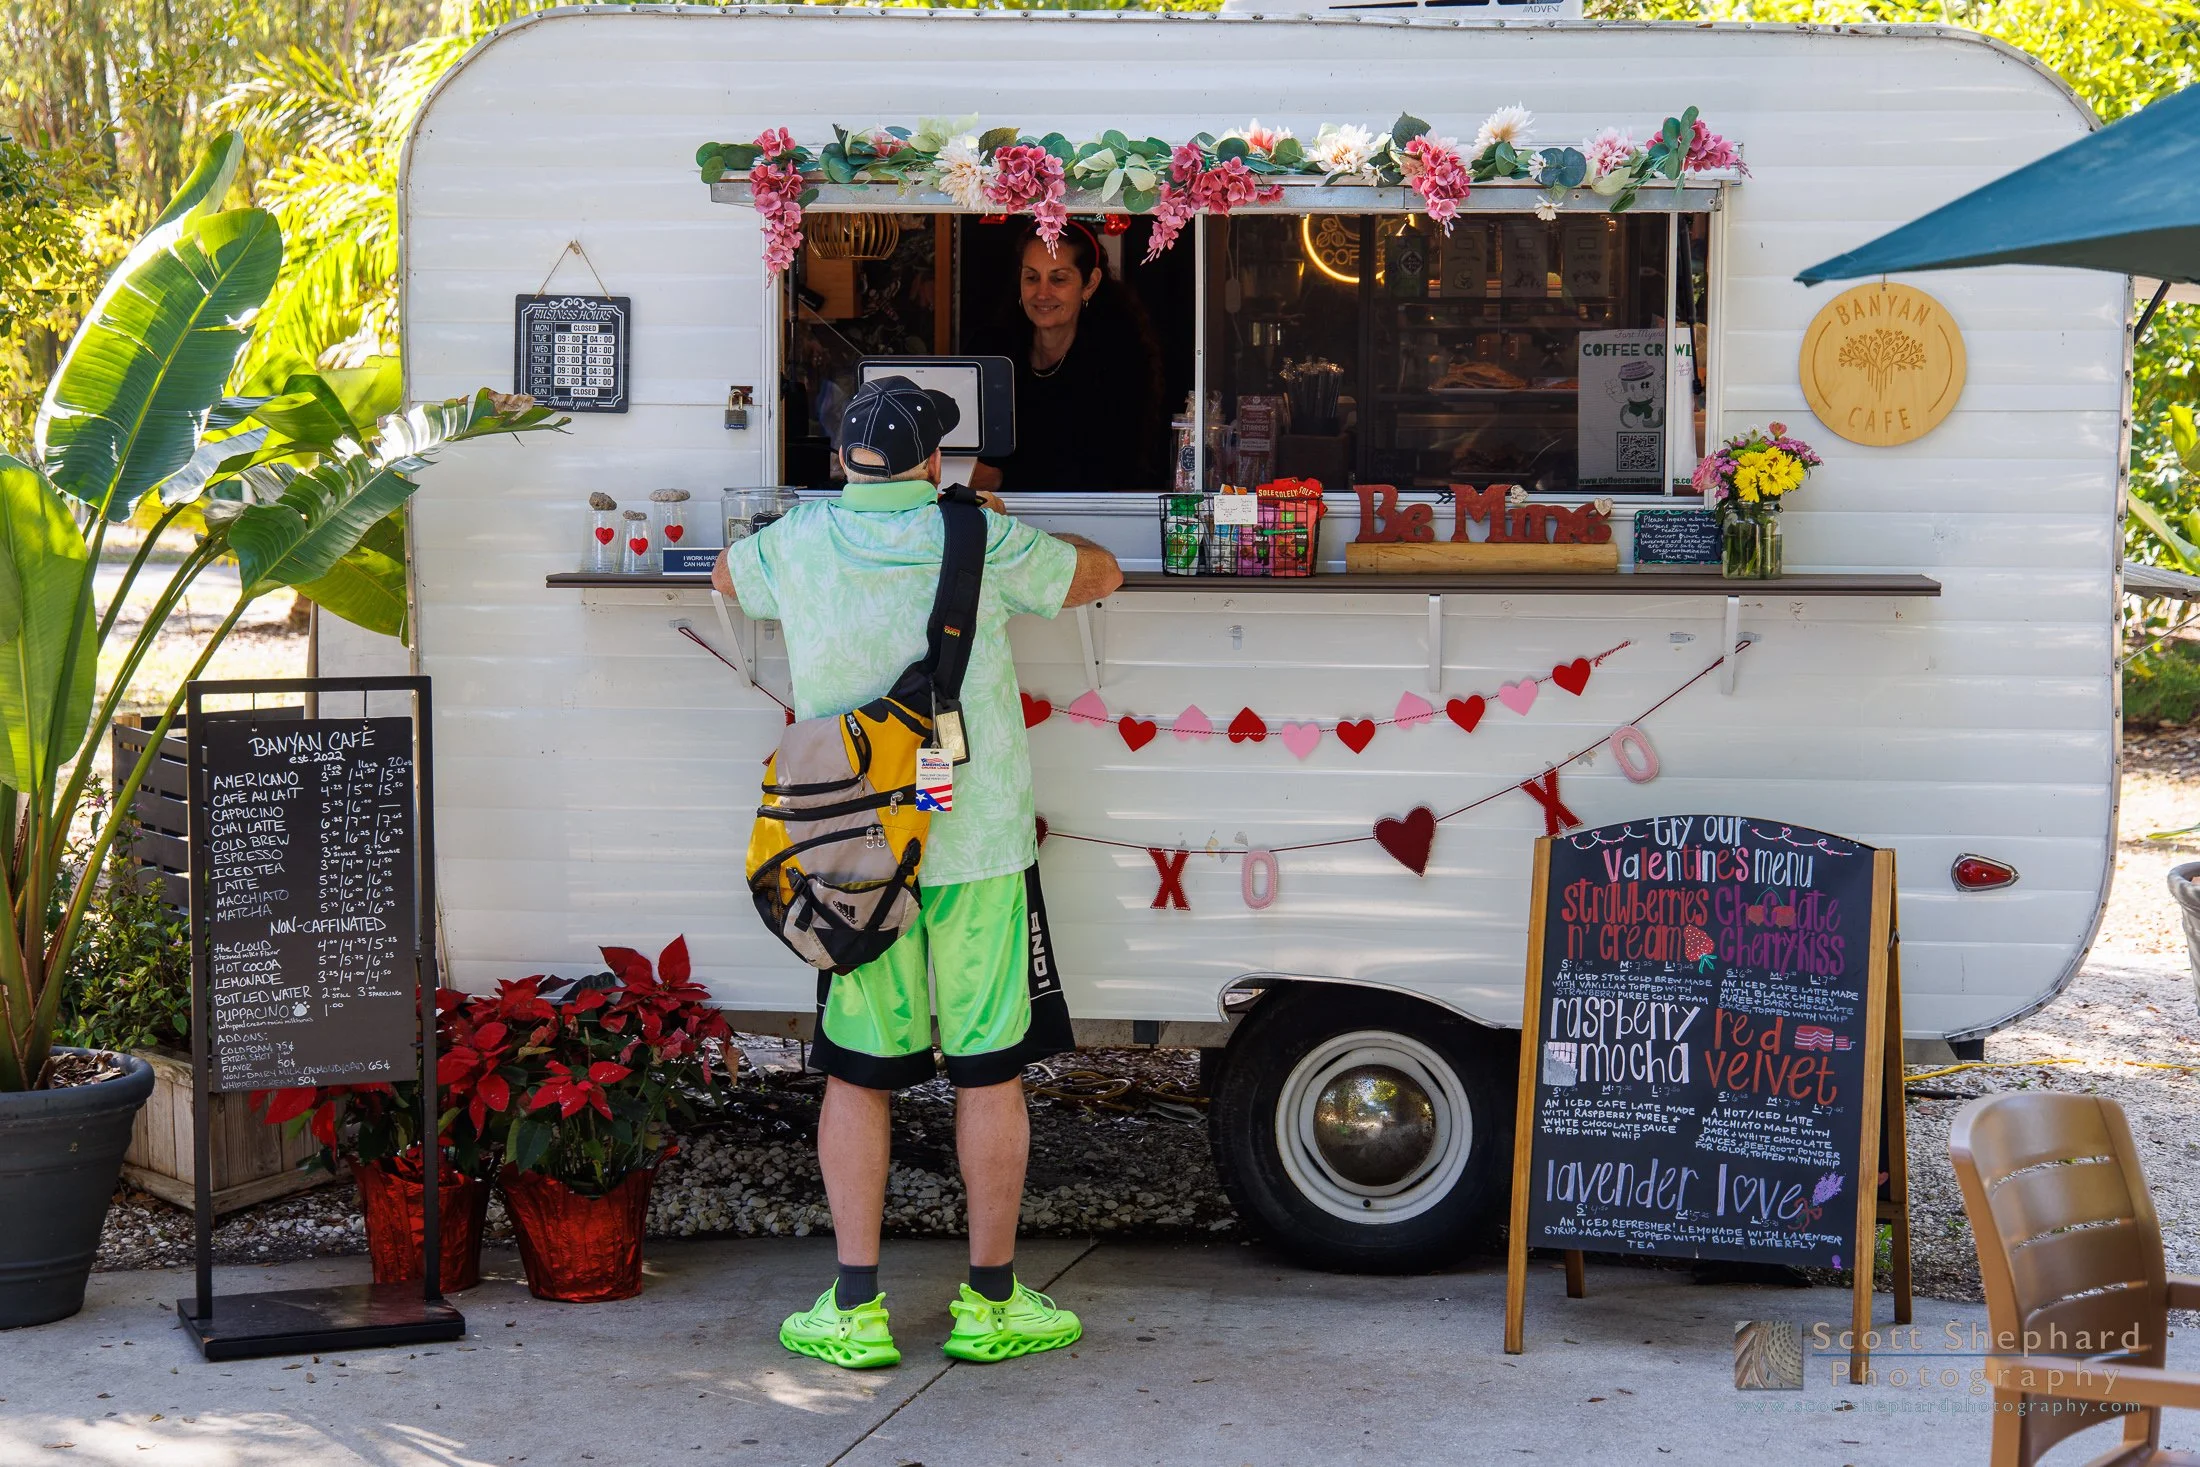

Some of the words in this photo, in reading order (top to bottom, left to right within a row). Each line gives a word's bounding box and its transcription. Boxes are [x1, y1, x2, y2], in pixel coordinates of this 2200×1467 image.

[534, 309, 578, 321] BUSINESS
[580, 310, 611, 321] HOURS
[1836, 295, 1931, 327] BANYAN
[1583, 344, 1640, 356] COFFEE
[1644, 344, 1693, 356] CRWL
[548, 397, 573, 406] Thank
[573, 400, 595, 410] you!
[1848, 407, 1911, 434] CAFE
[1353, 483, 1435, 544] Be
[248, 731, 322, 757] BANYAN
[213, 771, 298, 791] AMERICANO
[252, 791, 268, 802] AU
[271, 787, 304, 801] LAIT
[211, 806, 284, 822] CAPPUCINO
[211, 823, 242, 837] CHAI
[247, 820, 286, 834] LATTE
[1646, 816, 1694, 850] try
[1703, 815, 1750, 847] our
[211, 838, 246, 853] COLD
[252, 834, 290, 847] BREW
[214, 850, 283, 865] ESPRESSO
[1602, 844, 1749, 883] Valentine's
[1754, 847, 1814, 888] menu
[211, 866, 254, 879] ICED
[254, 862, 285, 875] TEA
[217, 878, 259, 895] LATTE
[1147, 848, 1190, 911] X
[1241, 850, 1278, 911] O
[217, 888, 290, 908] MACCHIATO
[1561, 877, 1710, 925] strawberries
[217, 904, 272, 923] MATCHA
[270, 916, 387, 936] NON-CAFFINATED
[234, 940, 271, 953] CLOUD
[1600, 923, 1681, 961] cream
[215, 963, 239, 975] HOT
[242, 959, 282, 972] COCOA
[215, 972, 284, 990] LEMONADE
[1557, 972, 1571, 980] AN
[1575, 973, 1598, 981] ICED
[1601, 974, 1625, 982] STOK
[1685, 978, 1712, 987] MADE
[1628, 983, 1663, 992] TOPPED
[214, 991, 269, 1007] BOTTLED
[272, 985, 312, 1000] WATER
[1556, 988, 1616, 998] STRAWBERRY
[1617, 991, 1650, 999] PUREE
[1678, 996, 1709, 1004] FOAM
[1754, 990, 1789, 1000] BLACK
[1792, 994, 1834, 1006] CHERRY
[216, 1004, 289, 1022] PUPPACINO
[1763, 999, 1792, 1008] DARK
[1793, 1002, 1854, 1015] CHOCOLATE
[1551, 996, 1701, 1050] raspberry
[1714, 1007, 1783, 1055] red
[221, 1053, 247, 1065] EXTRA
[1580, 1040, 1690, 1084] mocha
[222, 1063, 253, 1073] FLAVOR
[1704, 1049, 1837, 1106] velvet
[1574, 1108, 1632, 1119] RASPBERRY
[1636, 1113, 1668, 1123] PUREE
[1597, 1101, 1626, 1109] CAFE
[1631, 1102, 1661, 1112] LATTE
[1666, 1106, 1695, 1115] MADE
[1544, 1118, 1579, 1127] WHITE
[1642, 1124, 1676, 1133] SAUCE
[1702, 1117, 1761, 1130] MACCHIATO
[1785, 1114, 1814, 1126] LATTE
[1744, 1142, 1795, 1153] BEETROOT
[1798, 1148, 1840, 1159] POWDER
[1546, 1158, 1699, 1211] lavender
[1544, 1225, 1576, 1235] SYRUP
[1750, 1239, 1816, 1250] BUTTERFLY
[1612, 1219, 1676, 1233] REFRESHER!
[1680, 1225, 1742, 1237] LEMONADE
[1783, 1232, 1842, 1246] LAVENDER
[1627, 1240, 1655, 1249] TEA
